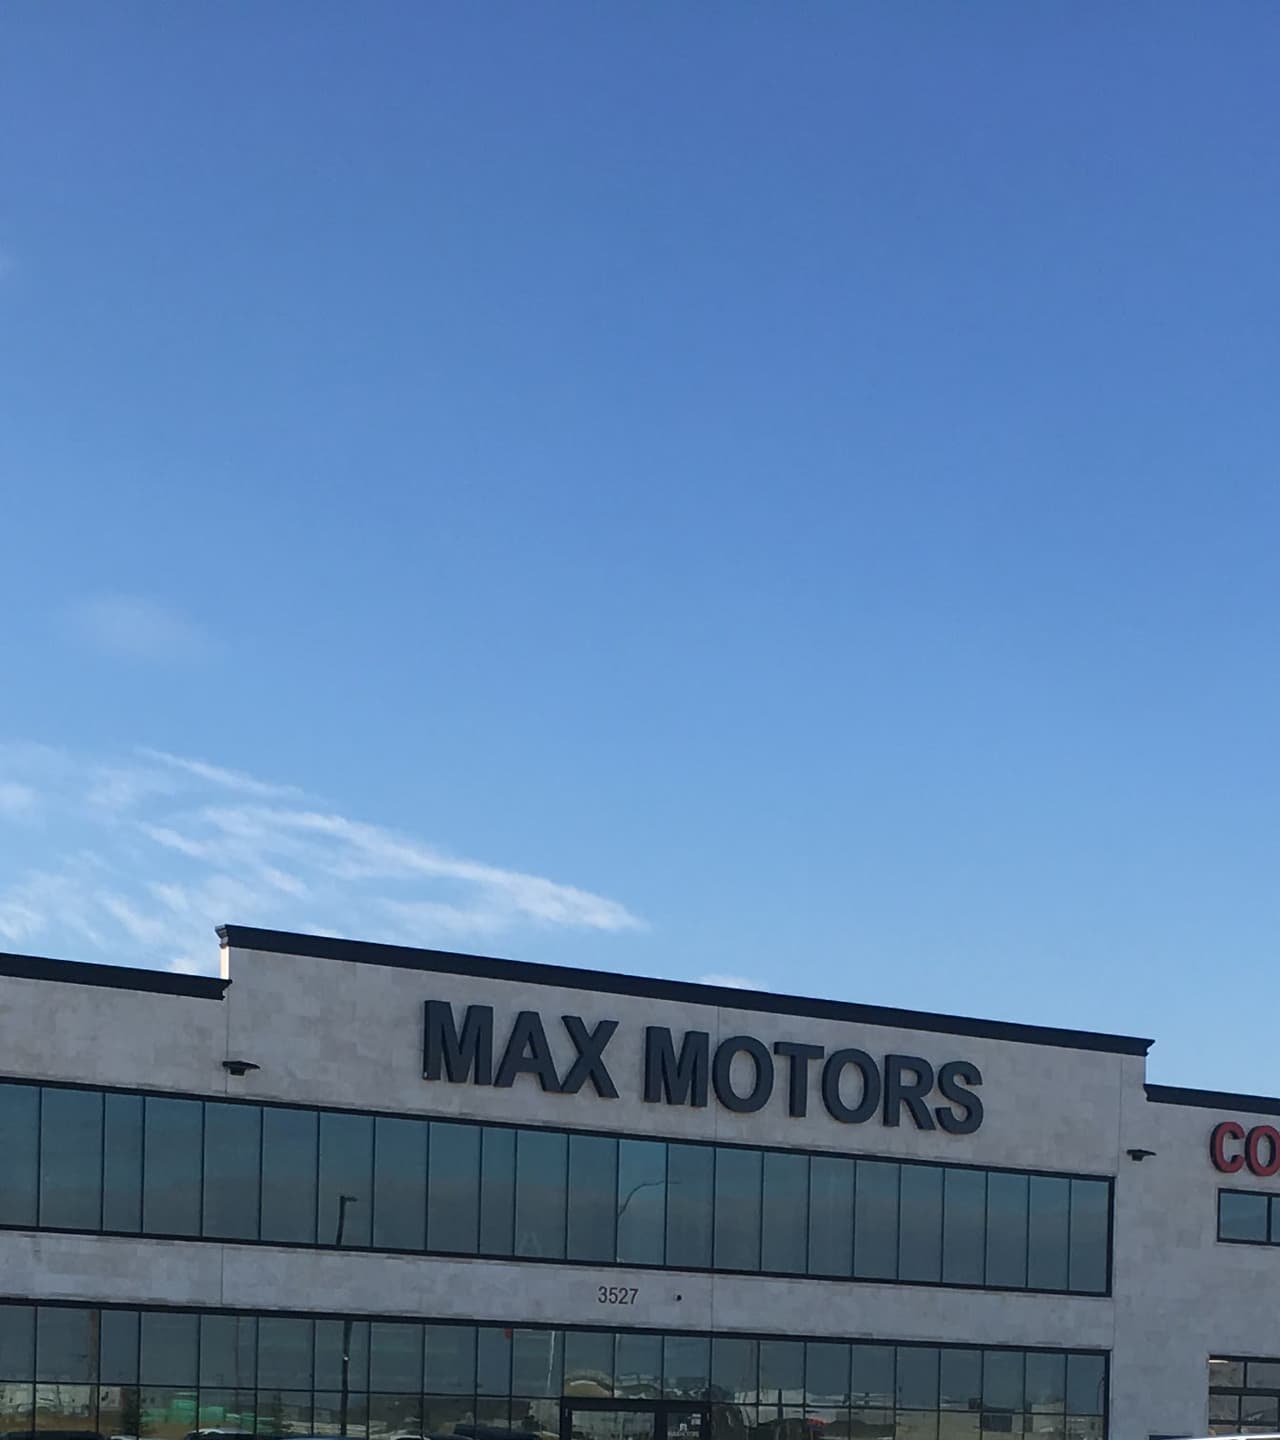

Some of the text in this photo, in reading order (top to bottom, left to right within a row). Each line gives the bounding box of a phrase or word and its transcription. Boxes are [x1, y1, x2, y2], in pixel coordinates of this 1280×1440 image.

[422, 999, 985, 1135] MAX MOTORS
[598, 1286, 639, 1305] 3527
